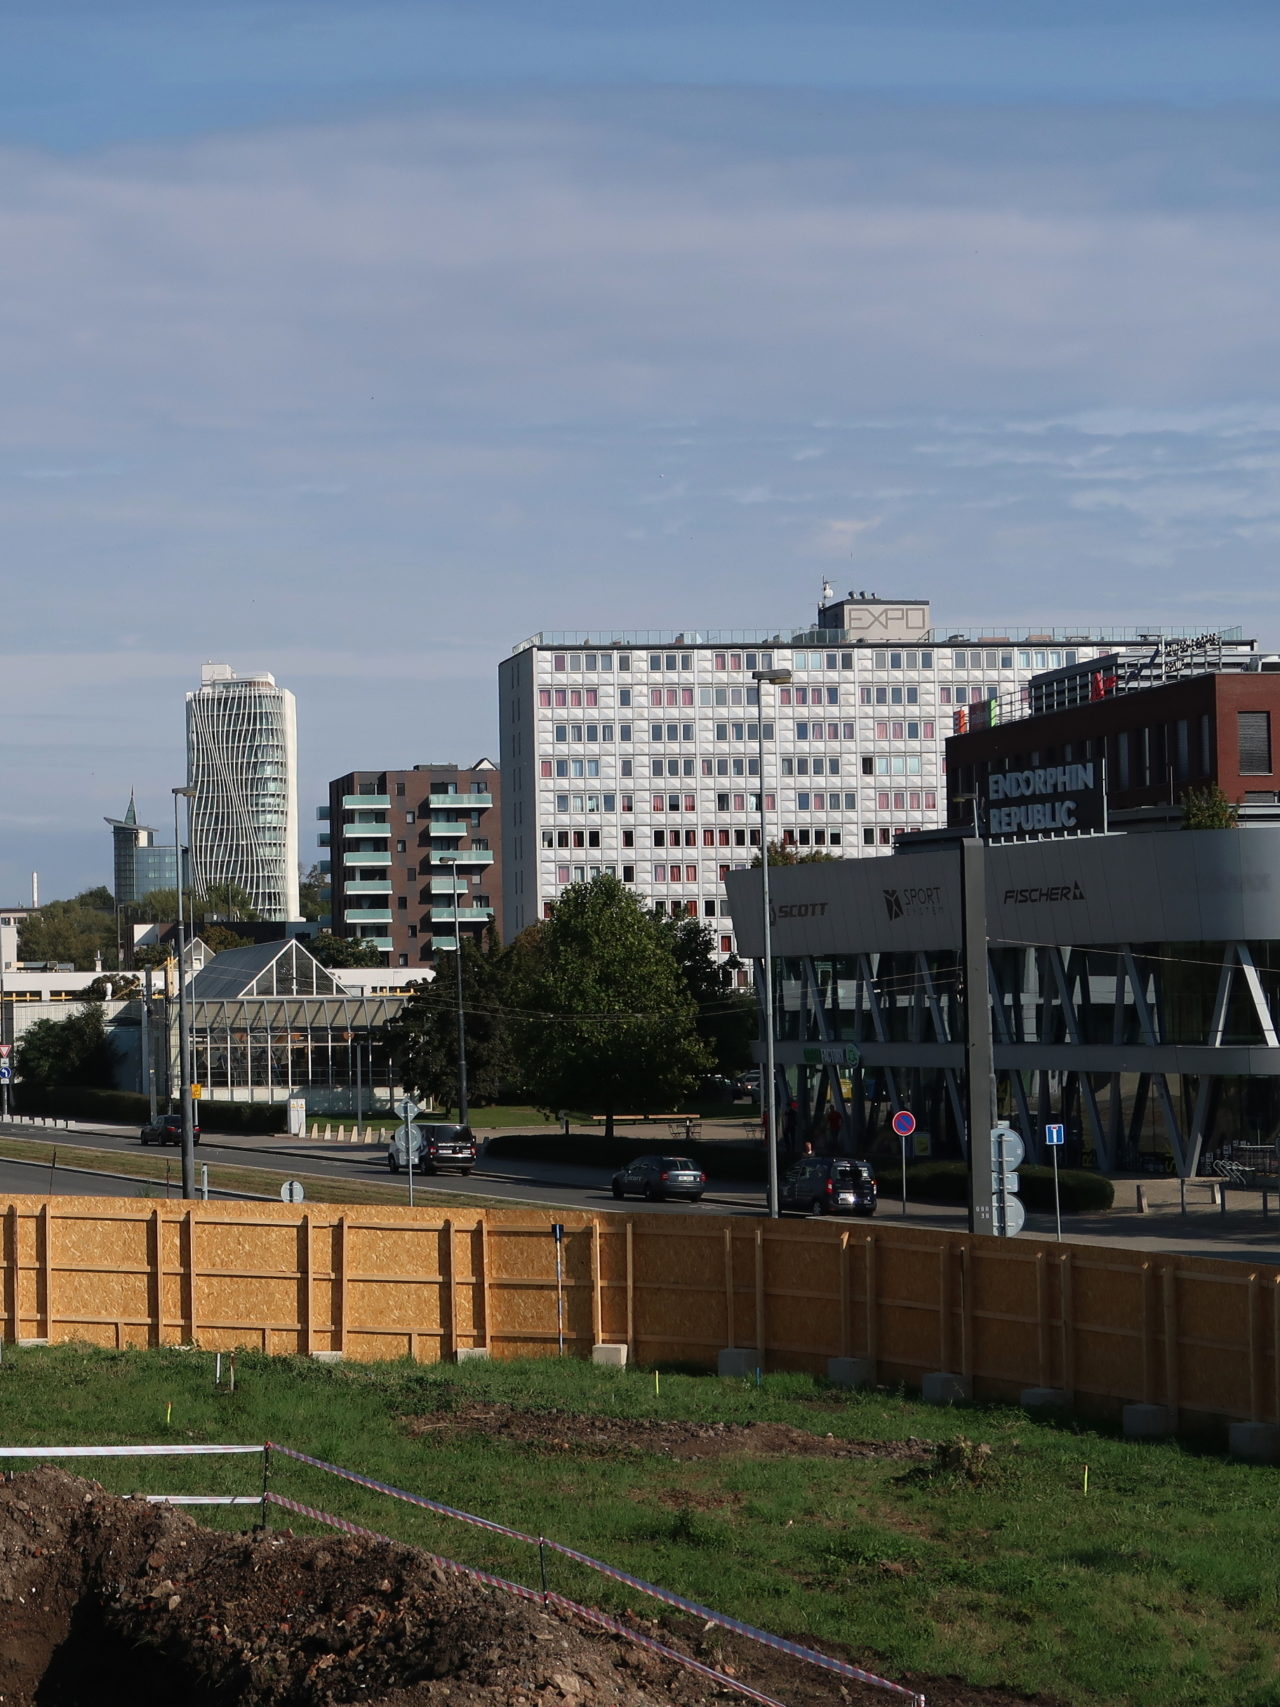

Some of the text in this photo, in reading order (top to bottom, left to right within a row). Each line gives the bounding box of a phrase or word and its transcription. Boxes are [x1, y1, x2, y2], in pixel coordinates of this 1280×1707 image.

[848, 608, 925, 630] EXPO
[988, 762, 1094, 801] ENDORPHIN
[989, 800, 1077, 834] REPUBLIC
[903, 886, 941, 905] SPORT
[1003, 886, 1072, 905] FISCHER
[778, 902, 829, 918] SCOTT
